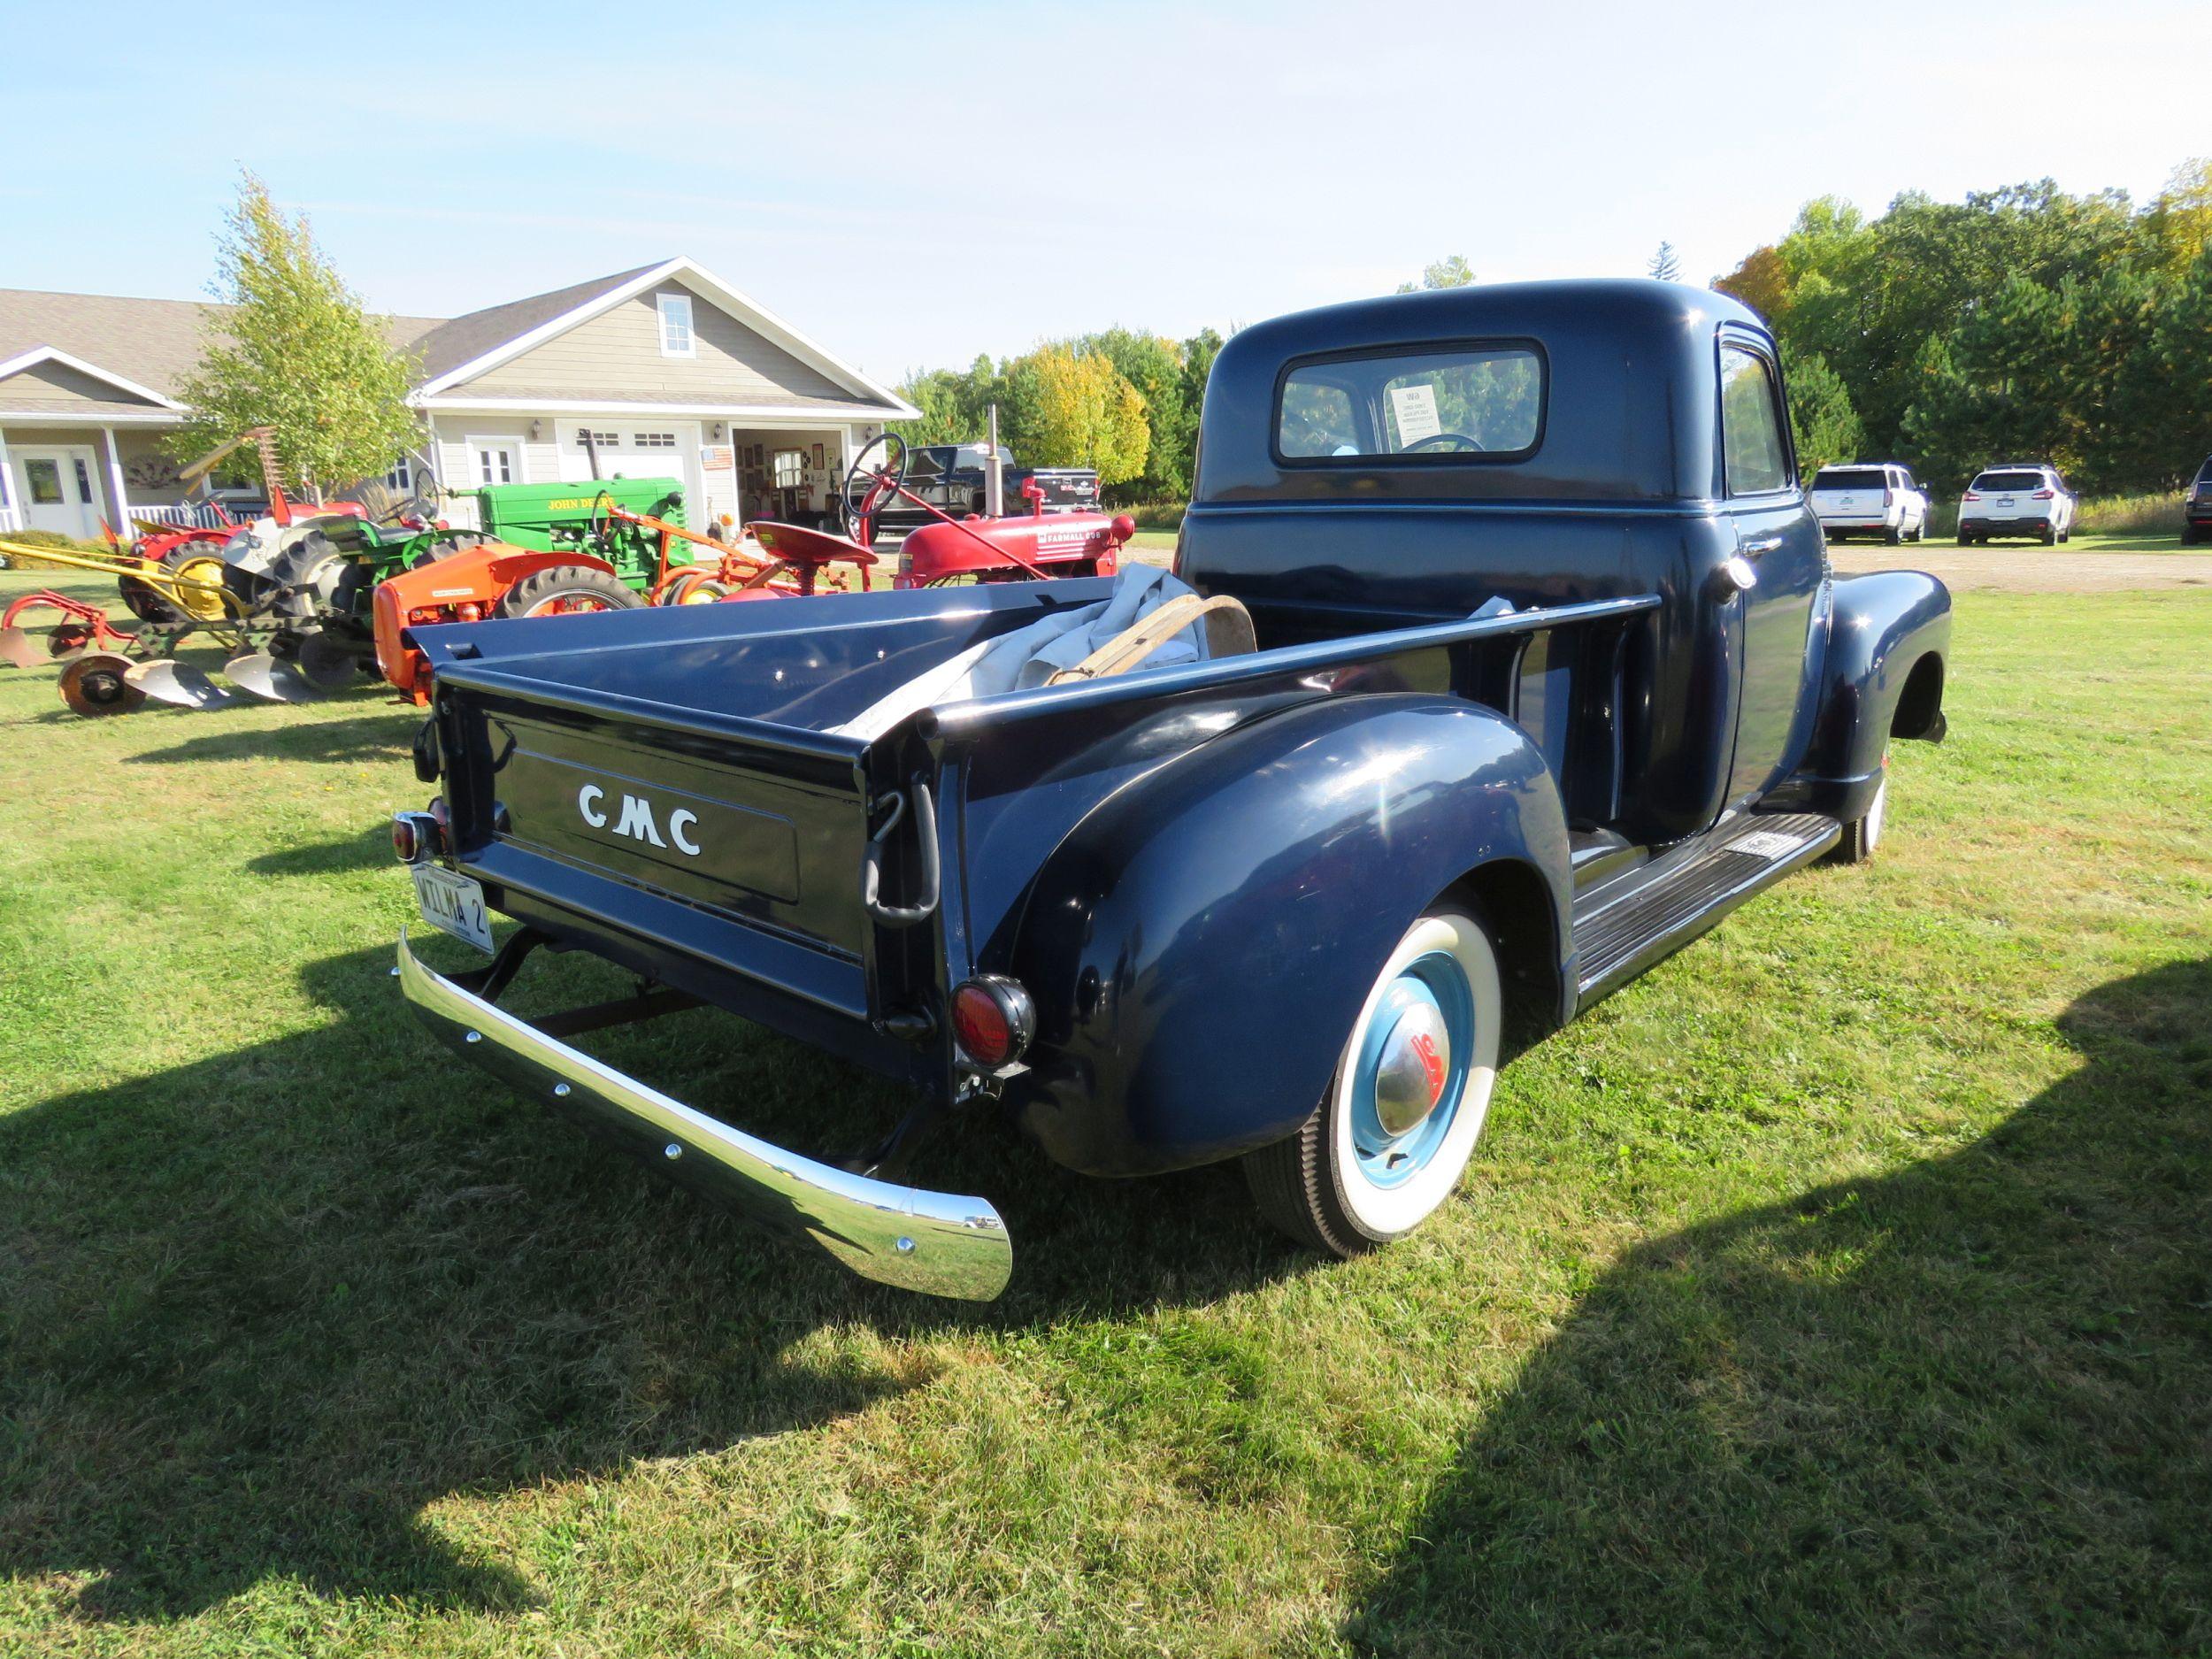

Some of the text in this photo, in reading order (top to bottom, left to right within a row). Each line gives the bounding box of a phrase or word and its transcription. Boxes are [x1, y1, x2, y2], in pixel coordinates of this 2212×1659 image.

[549, 499, 578, 510] JOHN
[1048, 533, 1085, 542] FARMALL
[580, 785, 701, 856] GMC
[417, 875, 486, 935] WILMA 2
